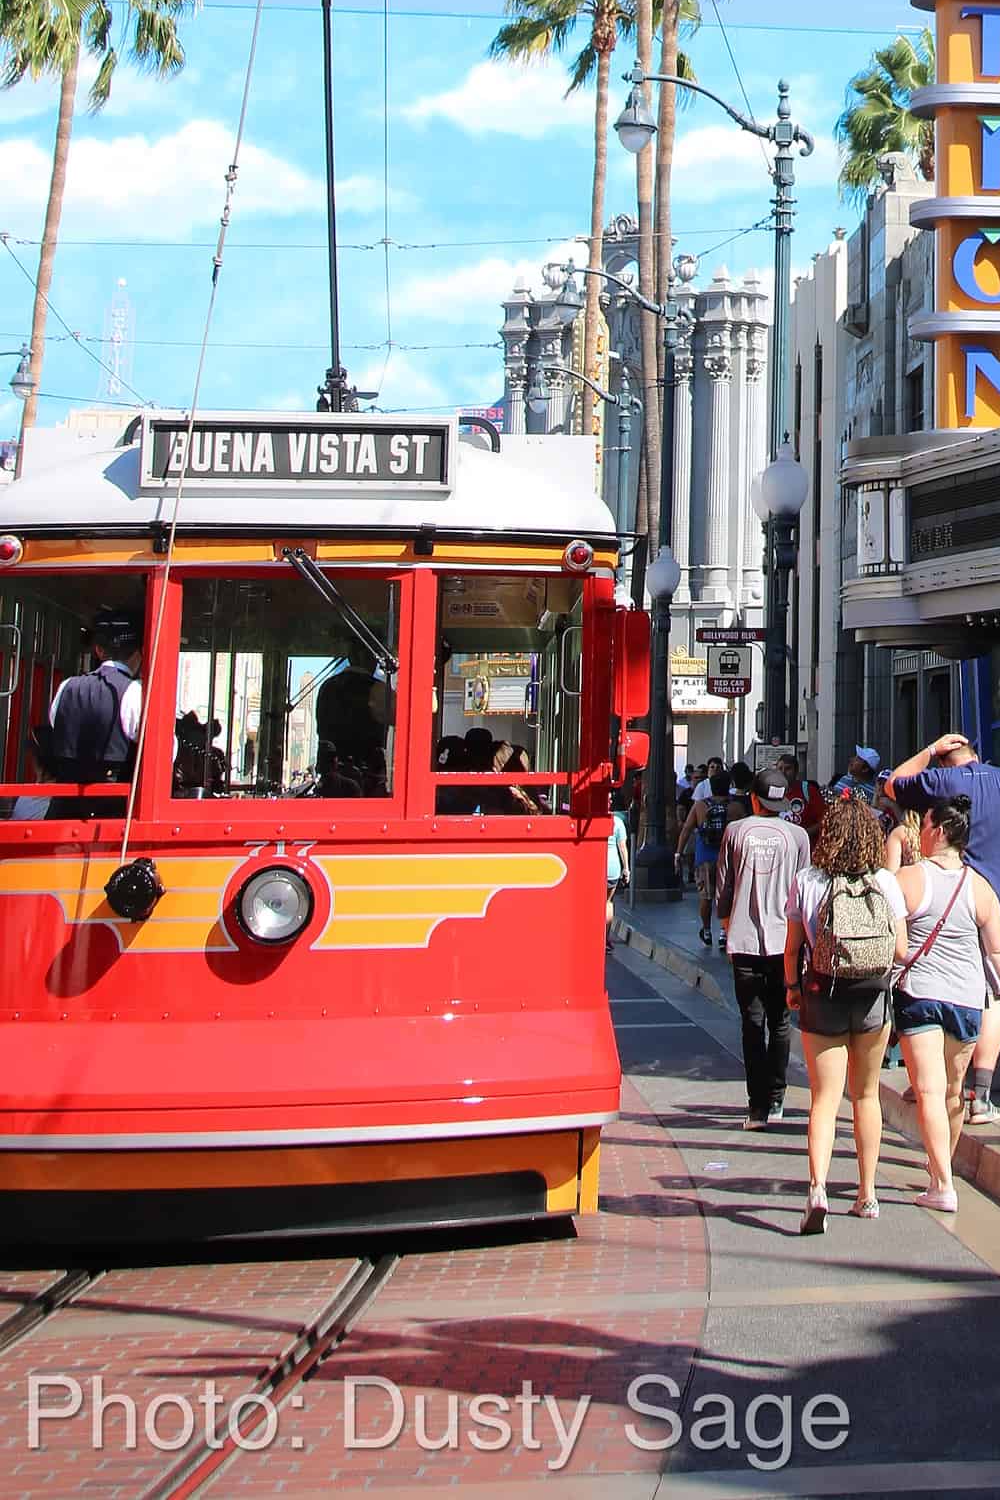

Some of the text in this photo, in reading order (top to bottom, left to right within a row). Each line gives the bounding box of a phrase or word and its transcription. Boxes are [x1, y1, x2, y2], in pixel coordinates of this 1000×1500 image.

[168, 431, 431, 475] BUENA VISTA ST
[243, 840, 318, 857] 717
